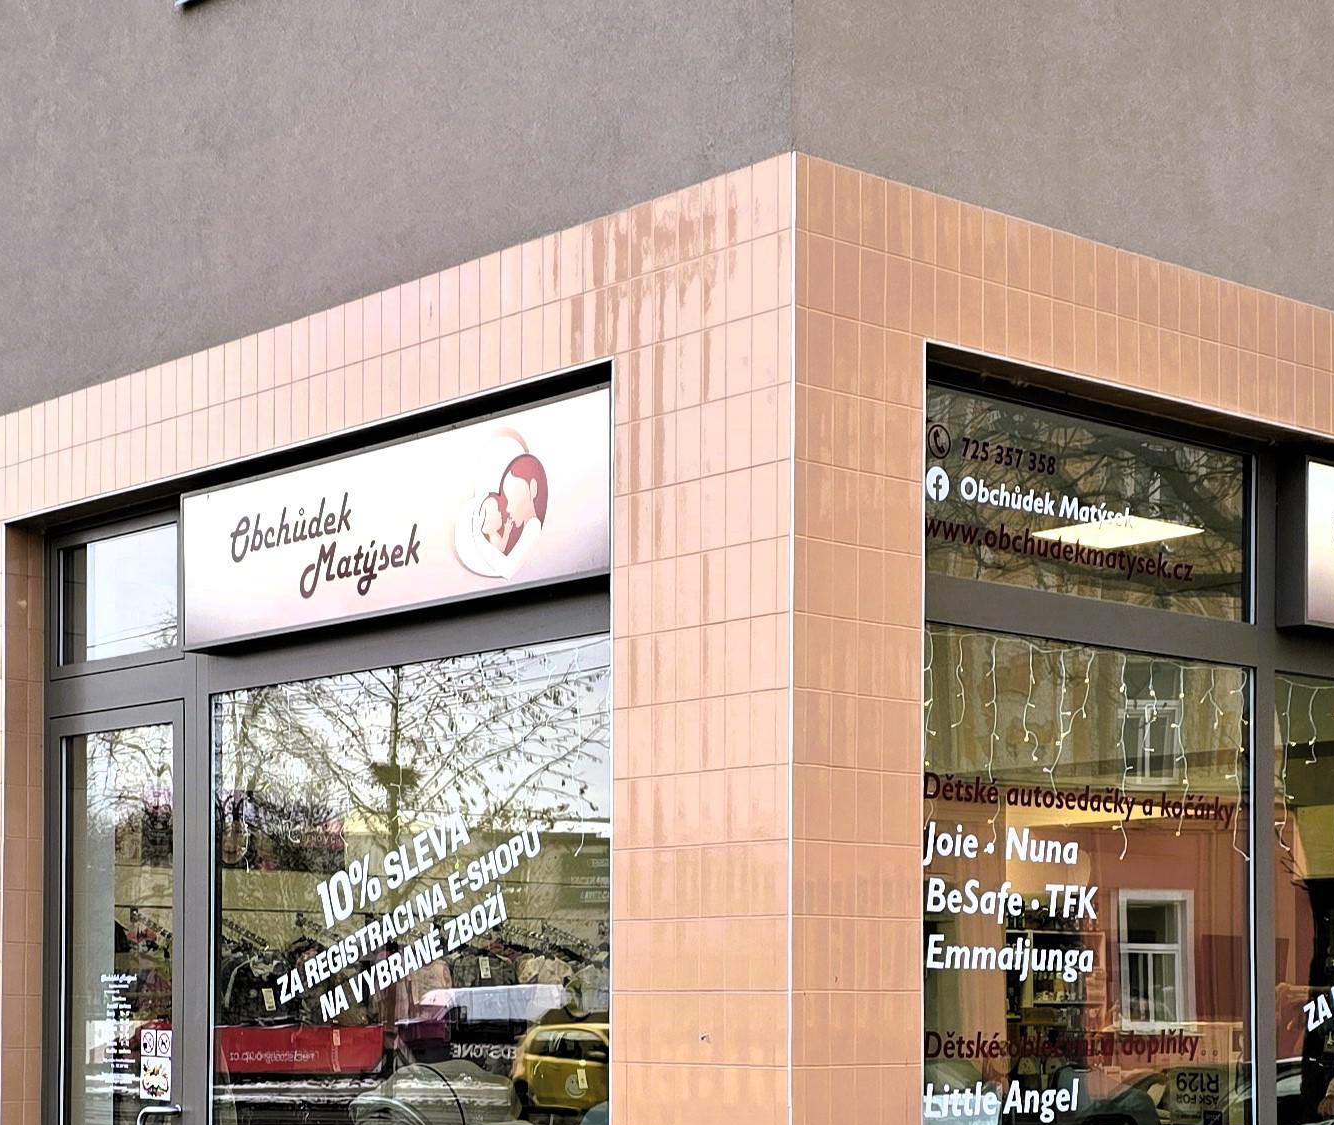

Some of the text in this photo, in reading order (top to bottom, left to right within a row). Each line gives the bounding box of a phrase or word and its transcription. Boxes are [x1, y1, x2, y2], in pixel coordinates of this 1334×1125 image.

[961, 437, 1056, 475] 725 357 358
[230, 492, 352, 563] Obchůdek
[960, 476, 1133, 529] Obchůdek Matýsek
[300, 523, 420, 599] Matýsek
[926, 518, 1195, 581] www.obchudekmatysek.cz
[923, 772, 1235, 829] Dětské autosedačky a kočárky
[922, 822, 1079, 866] Joie Nuna
[317, 812, 470, 929] 10% SLEVA
[276, 968, 305, 1004] ZA
[304, 901, 415, 988] REGISTRACI
[415, 883, 448, 922] NA
[447, 826, 542, 903] E-SHOPU
[926, 877, 1099, 924] BeSafe TFK
[319, 885, 509, 1023] NA VYBRANÉ ZBOŽÍ
[926, 934, 1094, 982] Emmaljunga
[1303, 994, 1332, 1032] ZA
[924, 1031, 1001, 1059] Dětské
[1122, 1029, 1199, 1061] doplňky
[923, 1077, 1080, 1123] Little Angel
[1176, 1072, 1219, 1093] R129
